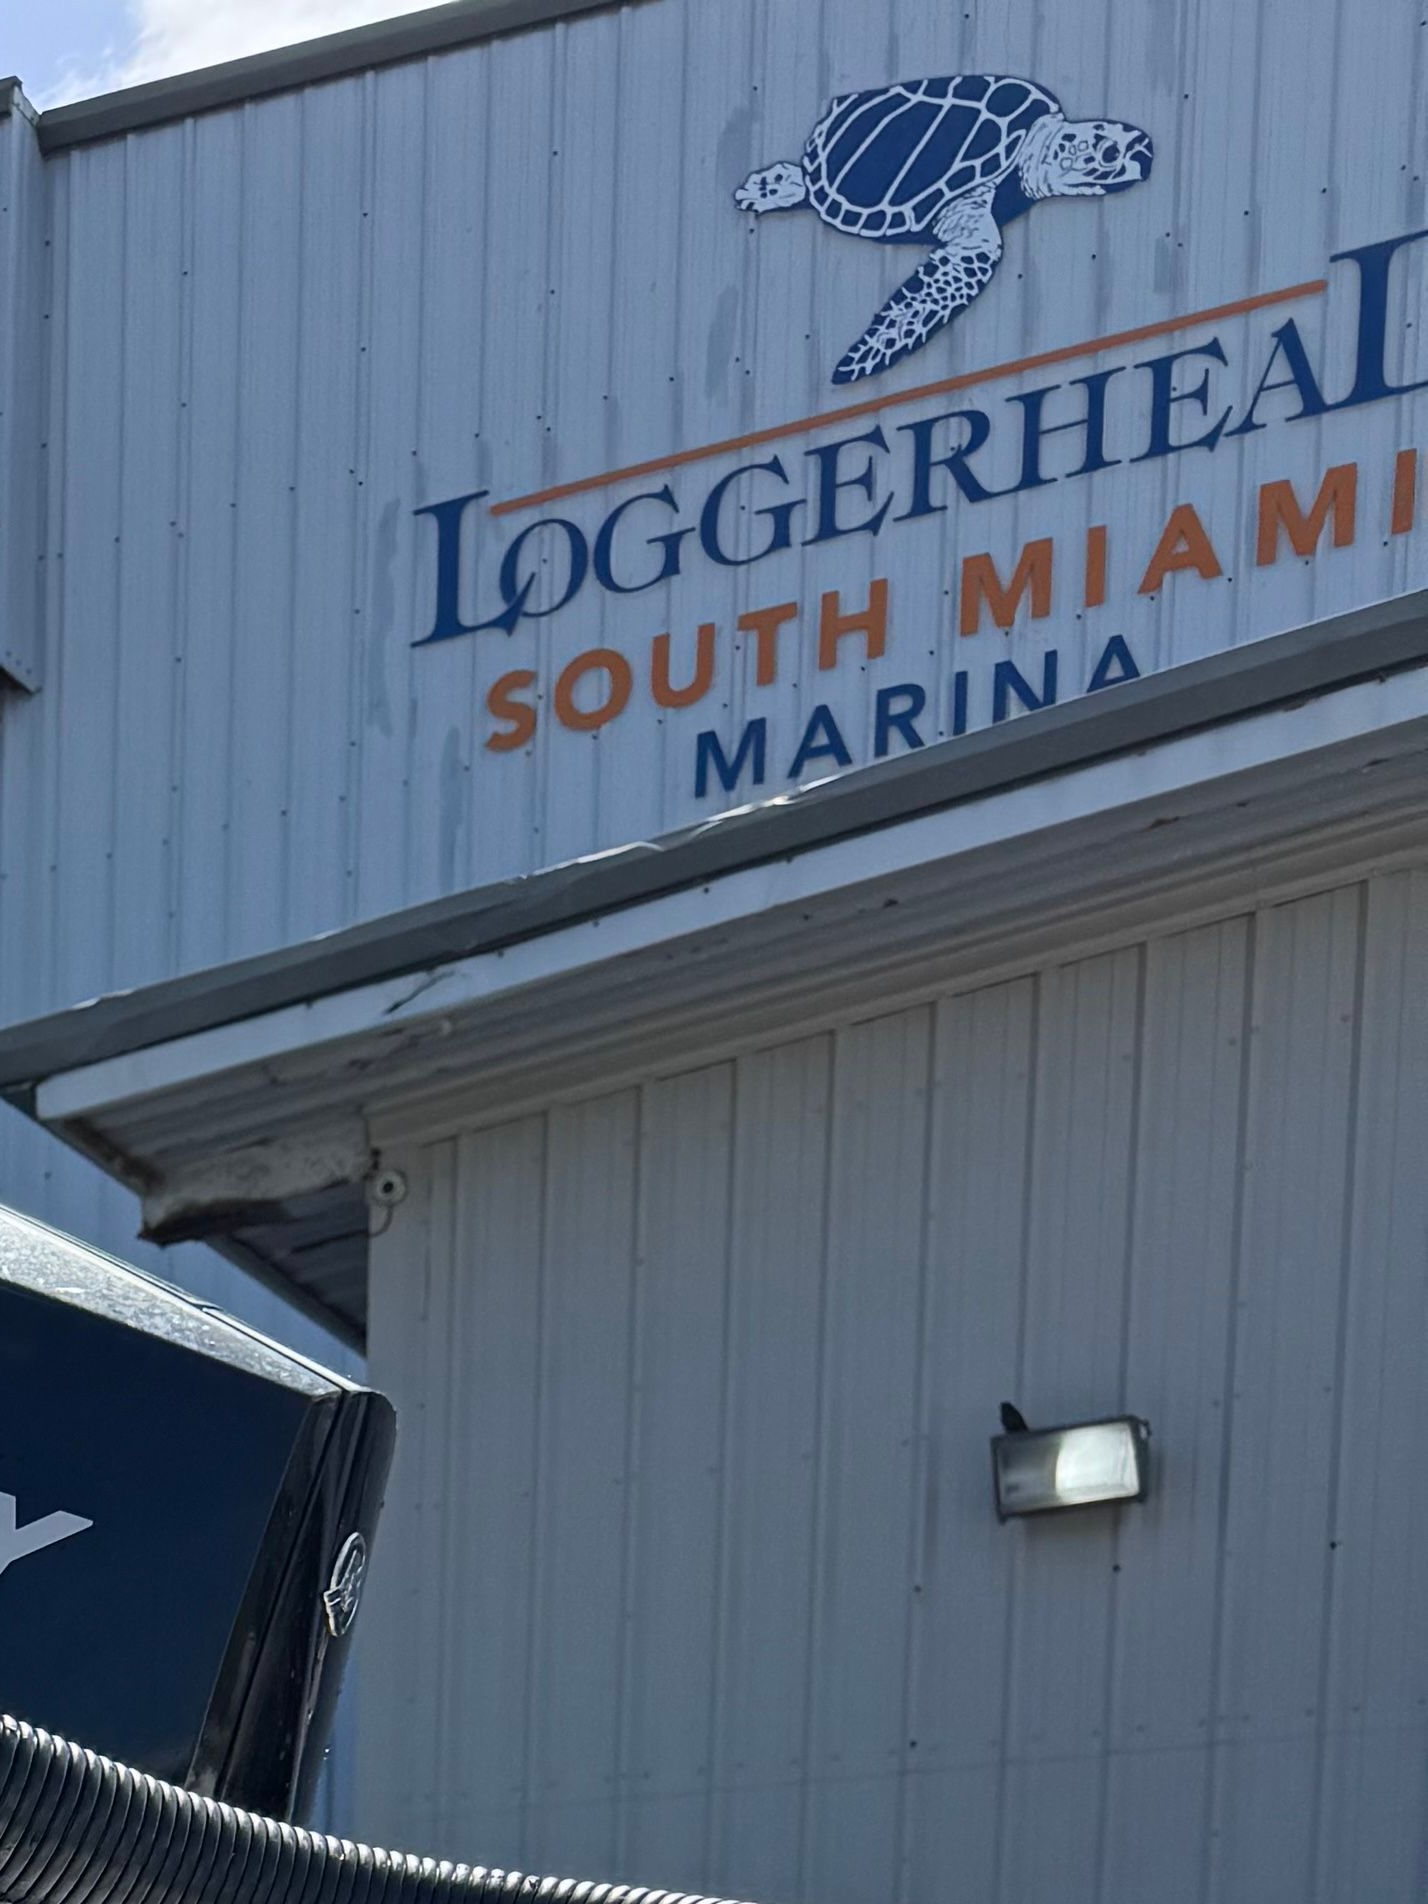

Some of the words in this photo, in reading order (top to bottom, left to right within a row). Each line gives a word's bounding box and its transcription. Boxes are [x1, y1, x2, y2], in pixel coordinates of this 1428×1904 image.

[485, 577, 888, 752] SOUTH
[959, 447, 1417, 638] MIAMI
[693, 634, 1141, 799] MARINA
